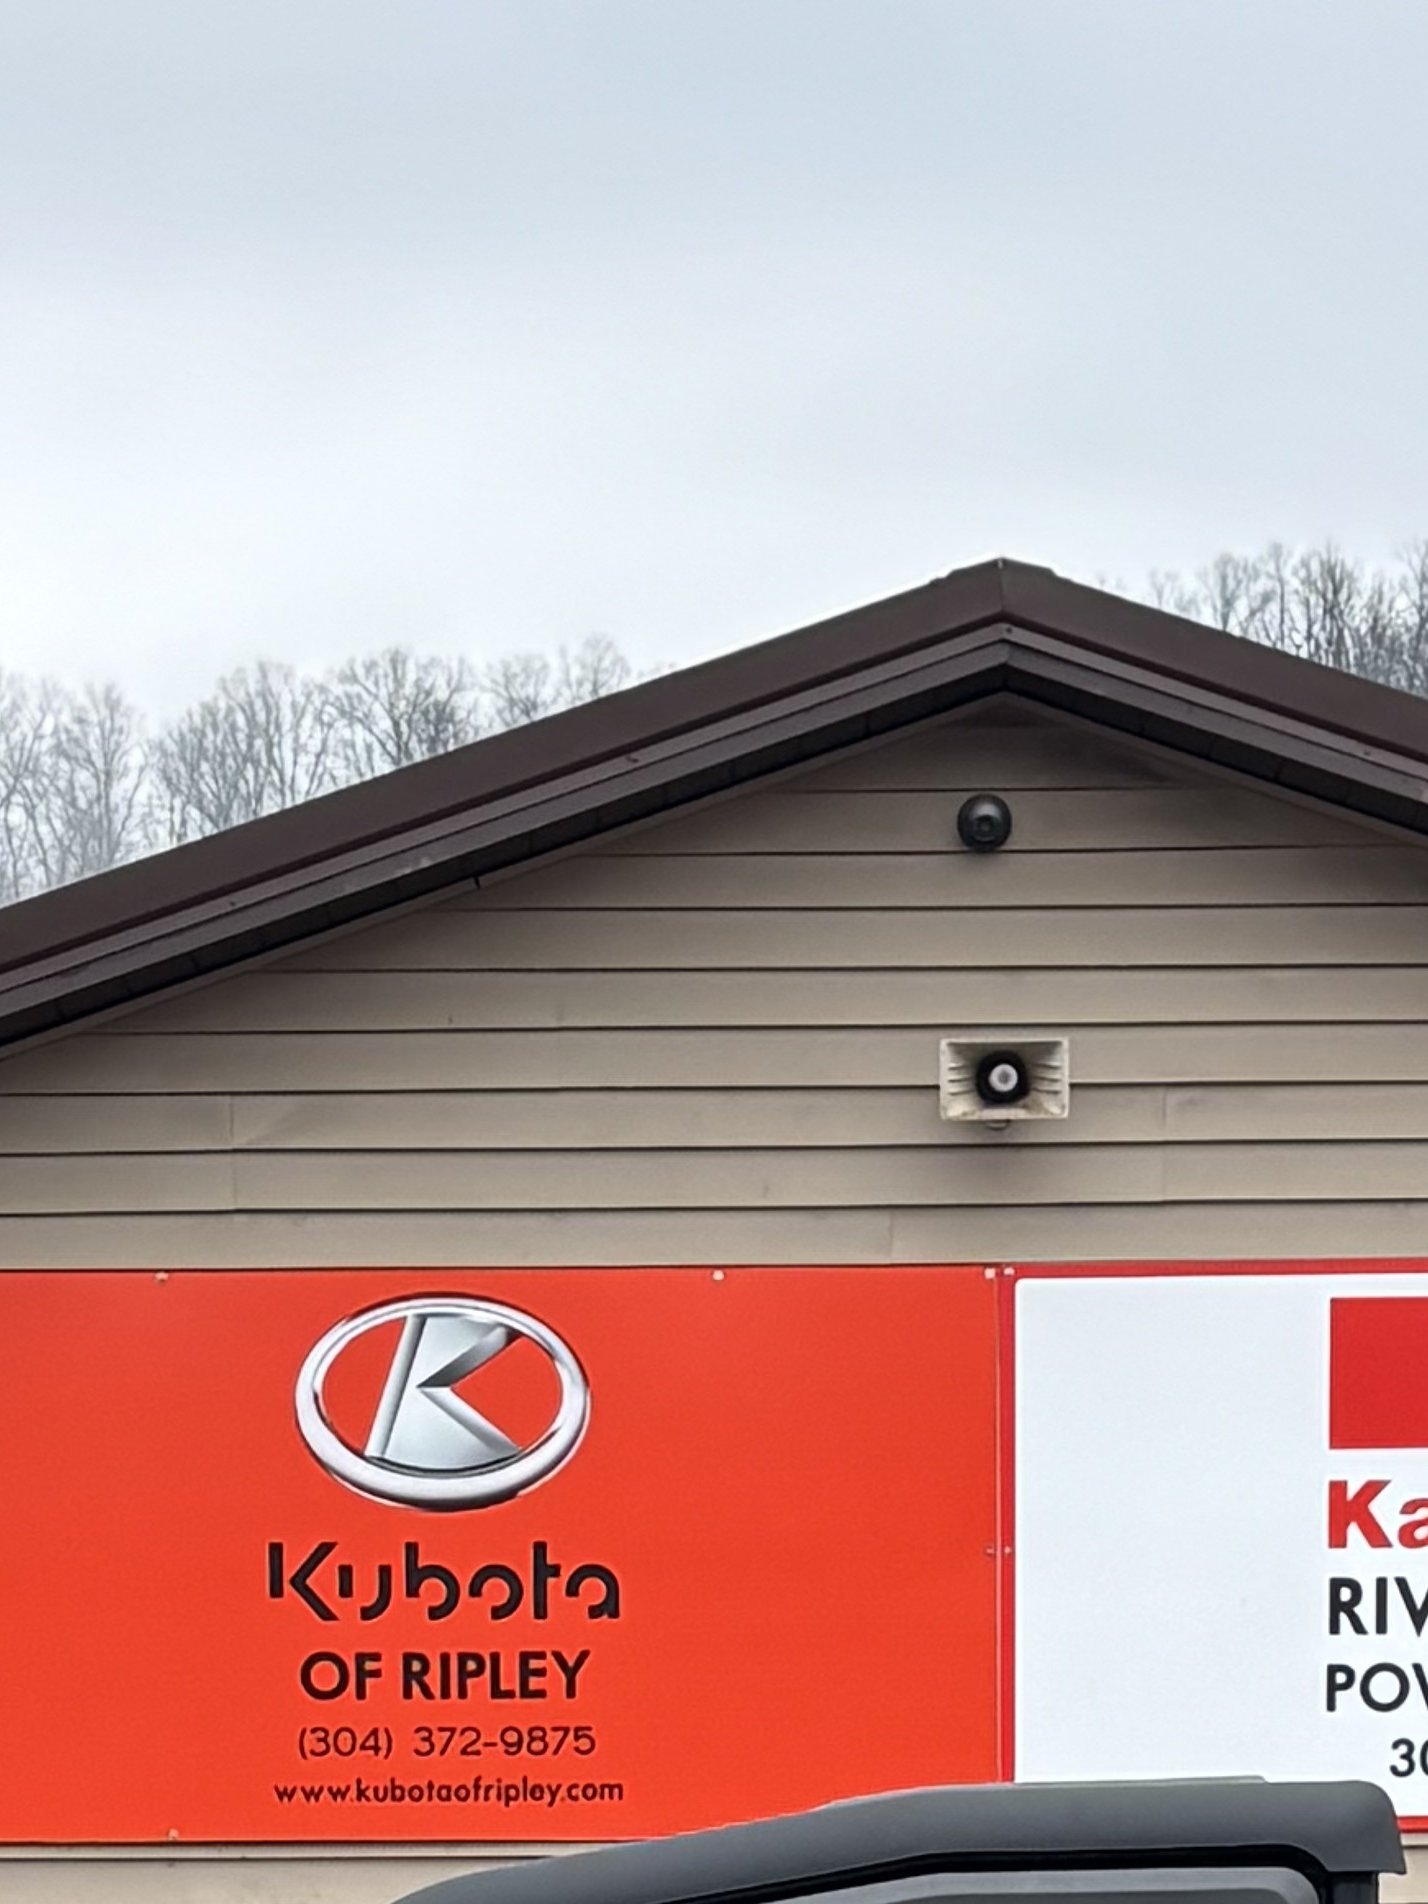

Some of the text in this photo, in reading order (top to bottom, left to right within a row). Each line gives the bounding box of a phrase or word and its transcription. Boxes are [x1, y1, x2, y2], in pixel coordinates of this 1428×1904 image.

[267, 1540, 621, 1622] Kubota
[300, 1649, 590, 1701] OF RIPLEY
[298, 1726, 596, 1760] (304) 372-9875
[274, 1775, 624, 1808] www.kubotaofripley.com
